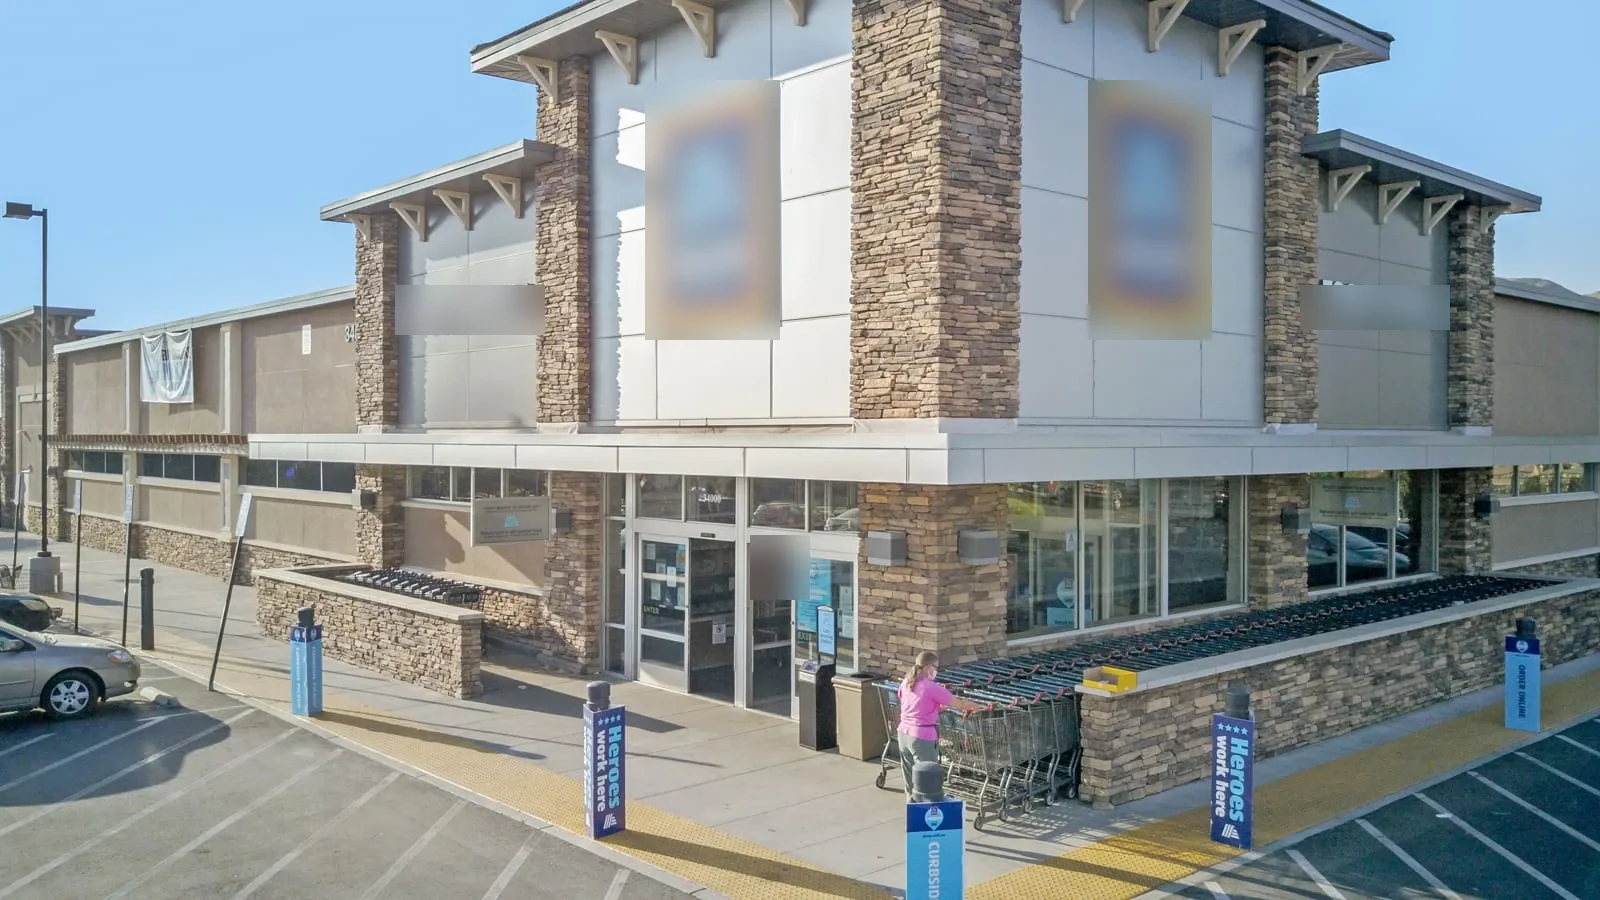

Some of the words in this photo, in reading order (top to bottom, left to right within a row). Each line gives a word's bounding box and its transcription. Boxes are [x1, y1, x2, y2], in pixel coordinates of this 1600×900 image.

[643, 605, 660, 614] ENTER
[1518, 664, 1526, 690] ORDER
[1518, 691, 1526, 718] ONLINE
[597, 729, 608, 772] work
[608, 725, 622, 809] Heroes
[1216, 735, 1229, 778] work
[597, 775, 609, 812] here
[1215, 779, 1229, 818] here
[1229, 736, 1249, 823] Heroes
[928, 841, 940, 900] CURBSID
